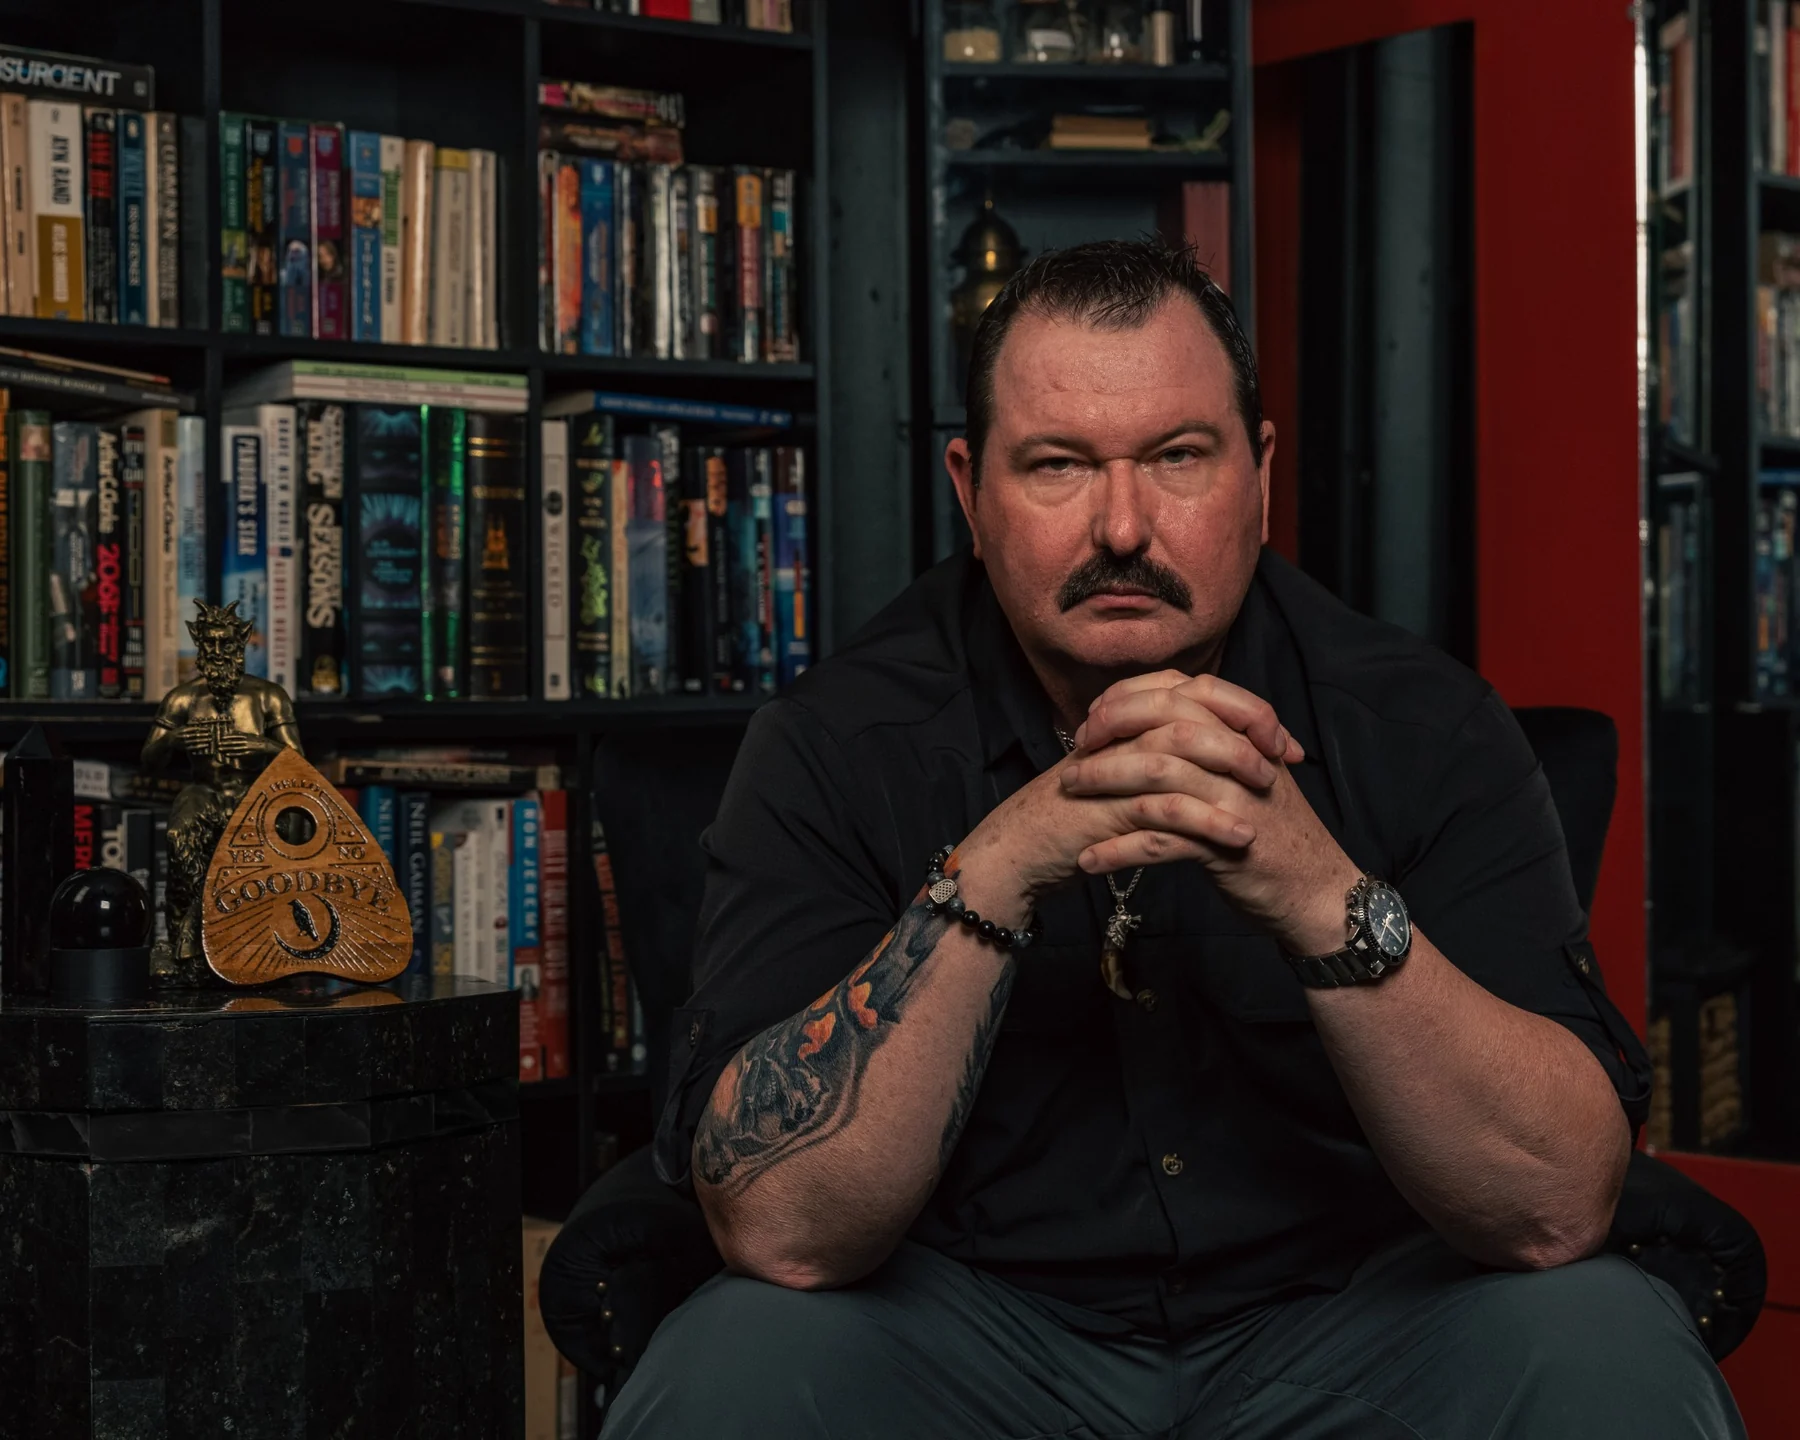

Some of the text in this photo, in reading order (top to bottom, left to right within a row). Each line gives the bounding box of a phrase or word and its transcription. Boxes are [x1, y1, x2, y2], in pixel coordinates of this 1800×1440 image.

[0, 55, 121, 96] SURGENT
[52, 134, 71, 205] AYN RAND
[97, 431, 118, 474] Arthur
[306, 419, 324, 486] KING
[278, 417, 291, 543] BRAVE NEW WORLD
[237, 519, 258, 556] STAR
[305, 502, 337, 629] SEASONS
[548, 524, 560, 609] WICKED
[270, 779, 320, 793] HELLO
[378, 798, 393, 846] NEIL
[228, 849, 266, 863] YES
[338, 846, 366, 860] NO
[408, 801, 427, 934] NEIL GAIMAN
[523, 807, 538, 942] RON JEREMY
[215, 870, 392, 913] GOODBYE
